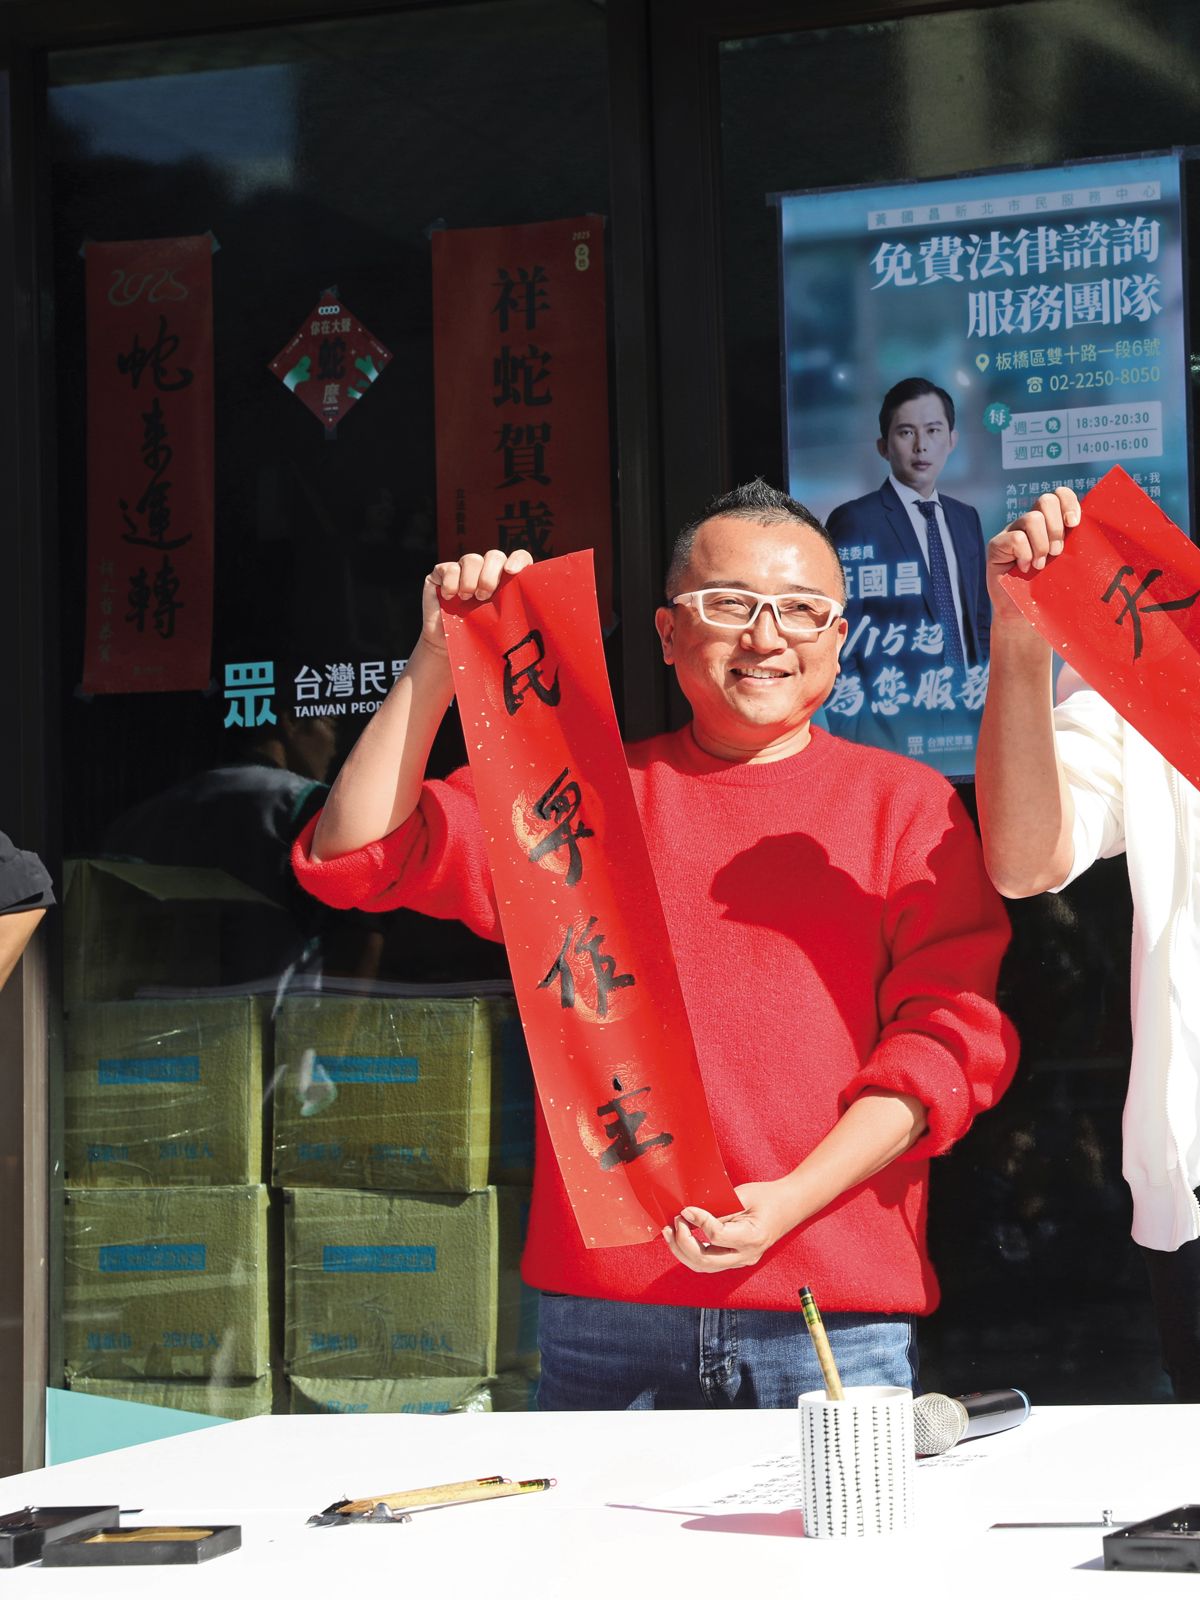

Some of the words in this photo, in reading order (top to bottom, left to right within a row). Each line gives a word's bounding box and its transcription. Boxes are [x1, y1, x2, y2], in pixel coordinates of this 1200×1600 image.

[875, 184, 1158, 227] 黃國昌新北市民服務中心
[869, 215, 1161, 291] 免費法律諮詢
[966, 273, 1163, 339] 服務團隊
[995, 338, 1161, 372] 板橋區雙十路一段6號
[1049, 366, 1161, 392] 02-2250-8050
[490, 265, 556, 559] 祥蛇賀歲
[1076, 412, 1150, 429] 18:30-20:30
[1077, 437, 1149, 454] 14:00-16:00
[1006, 478, 1102, 495] 為了避免現場等候
[224, 661, 277, 728] 眾
[824, 664, 990, 717] 為您服務
[294, 704, 346, 717] TAIWAN
